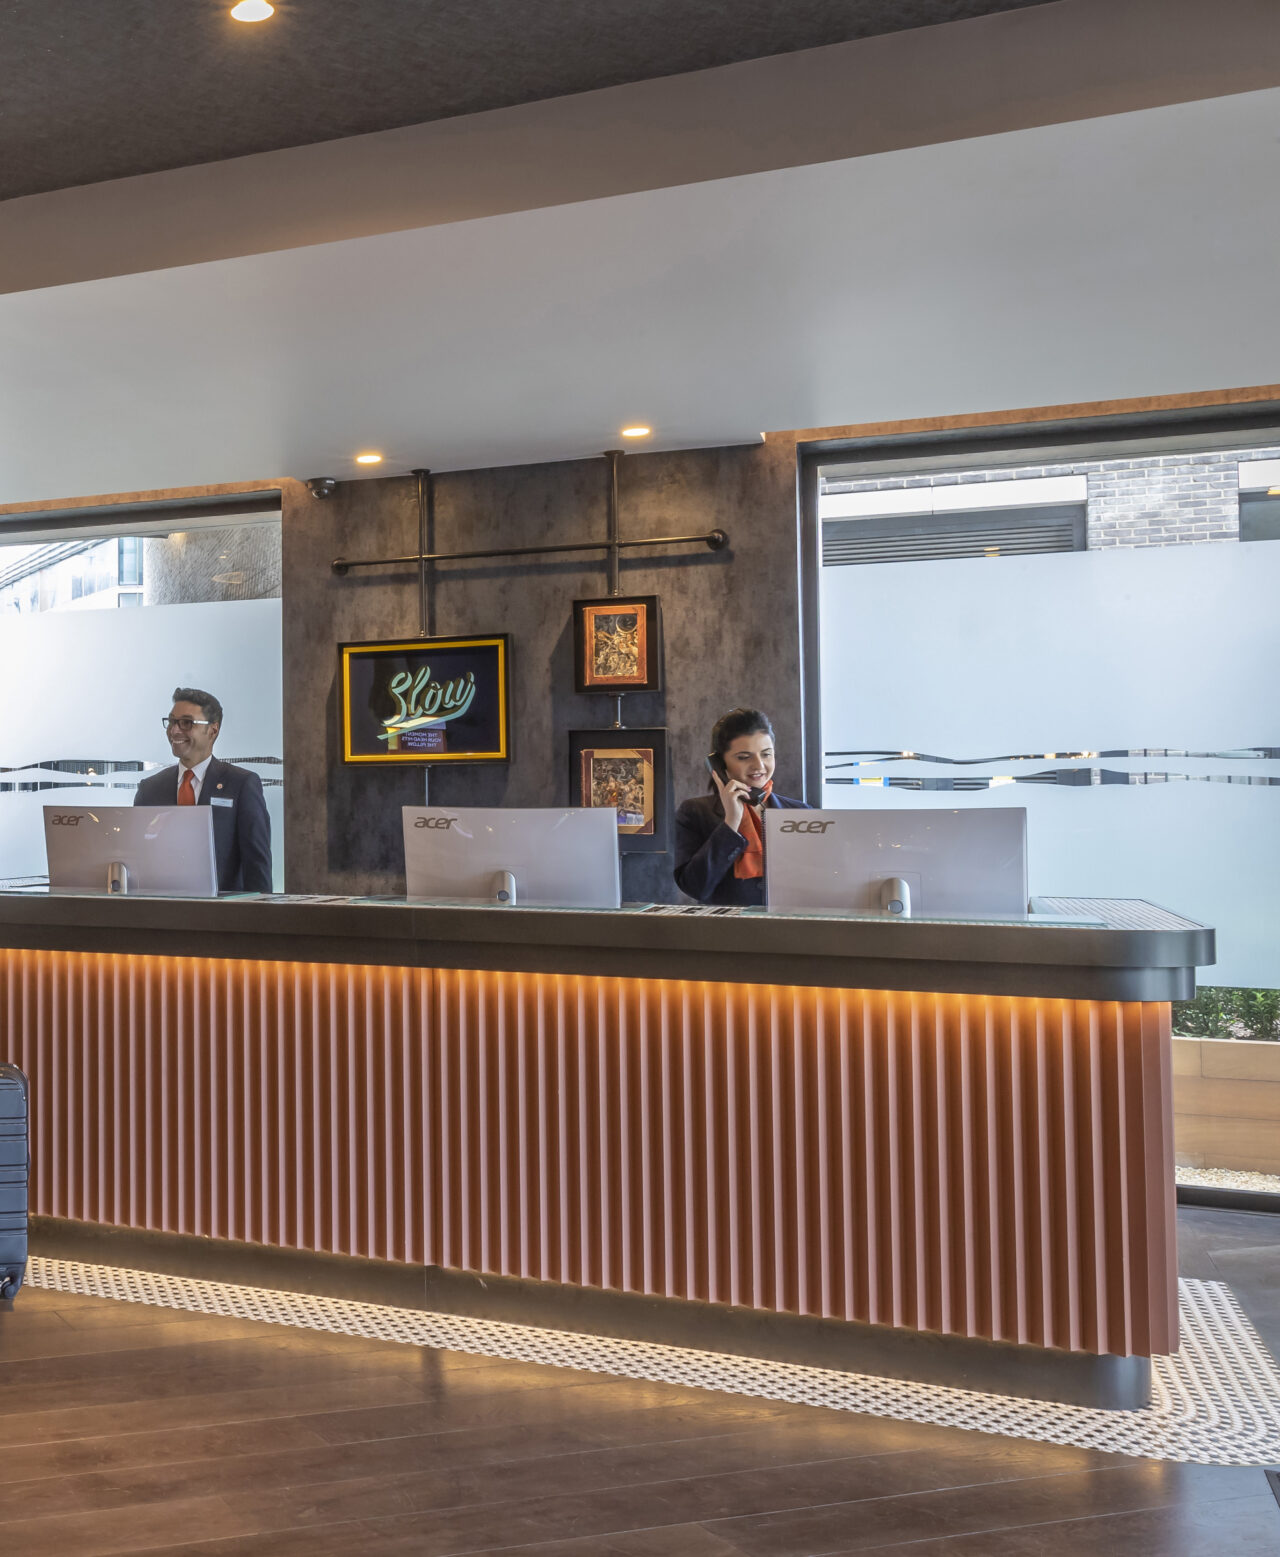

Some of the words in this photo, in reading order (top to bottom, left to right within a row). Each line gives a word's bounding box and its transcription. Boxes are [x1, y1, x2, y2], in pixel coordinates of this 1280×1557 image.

[377, 665, 476, 740] Slow
[52, 815, 84, 826] acer
[414, 816, 457, 830] acer
[780, 820, 835, 834] acer
